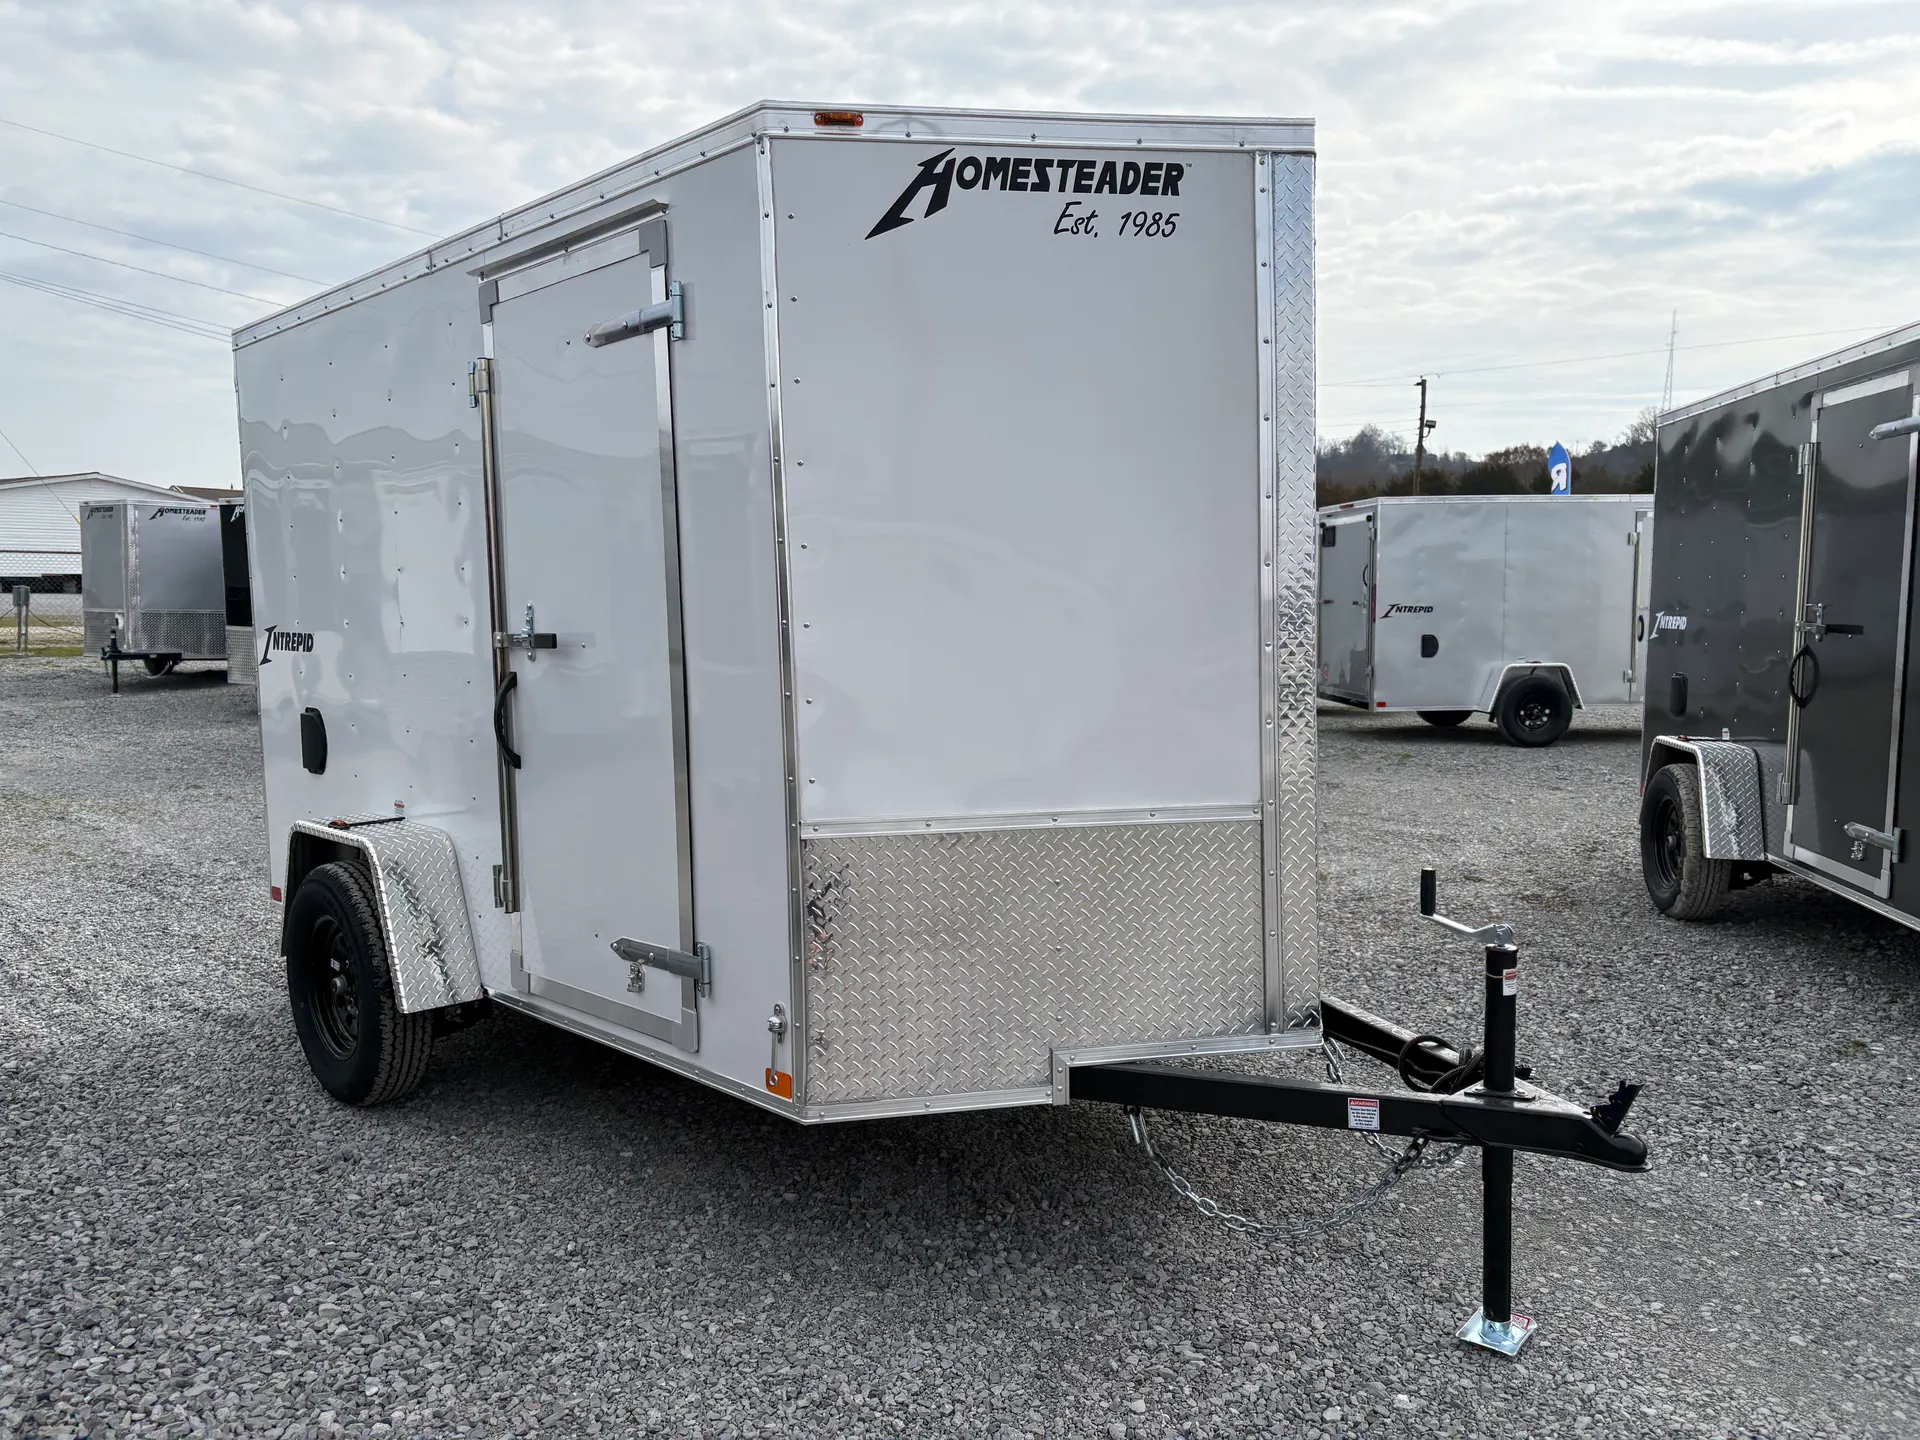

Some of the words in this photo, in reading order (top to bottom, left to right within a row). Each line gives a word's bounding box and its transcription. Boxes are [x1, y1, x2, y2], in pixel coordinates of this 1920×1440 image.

[865, 147, 1185, 240] HOMESTEADER
[1054, 201, 1098, 238] Est.
[1118, 211, 1181, 238] 1985
[149, 506, 207, 520] HOMESTEADER
[1379, 603, 1434, 619] INTREPID
[1649, 610, 1687, 640] INTREPID
[259, 624, 314, 666] INTREPID
